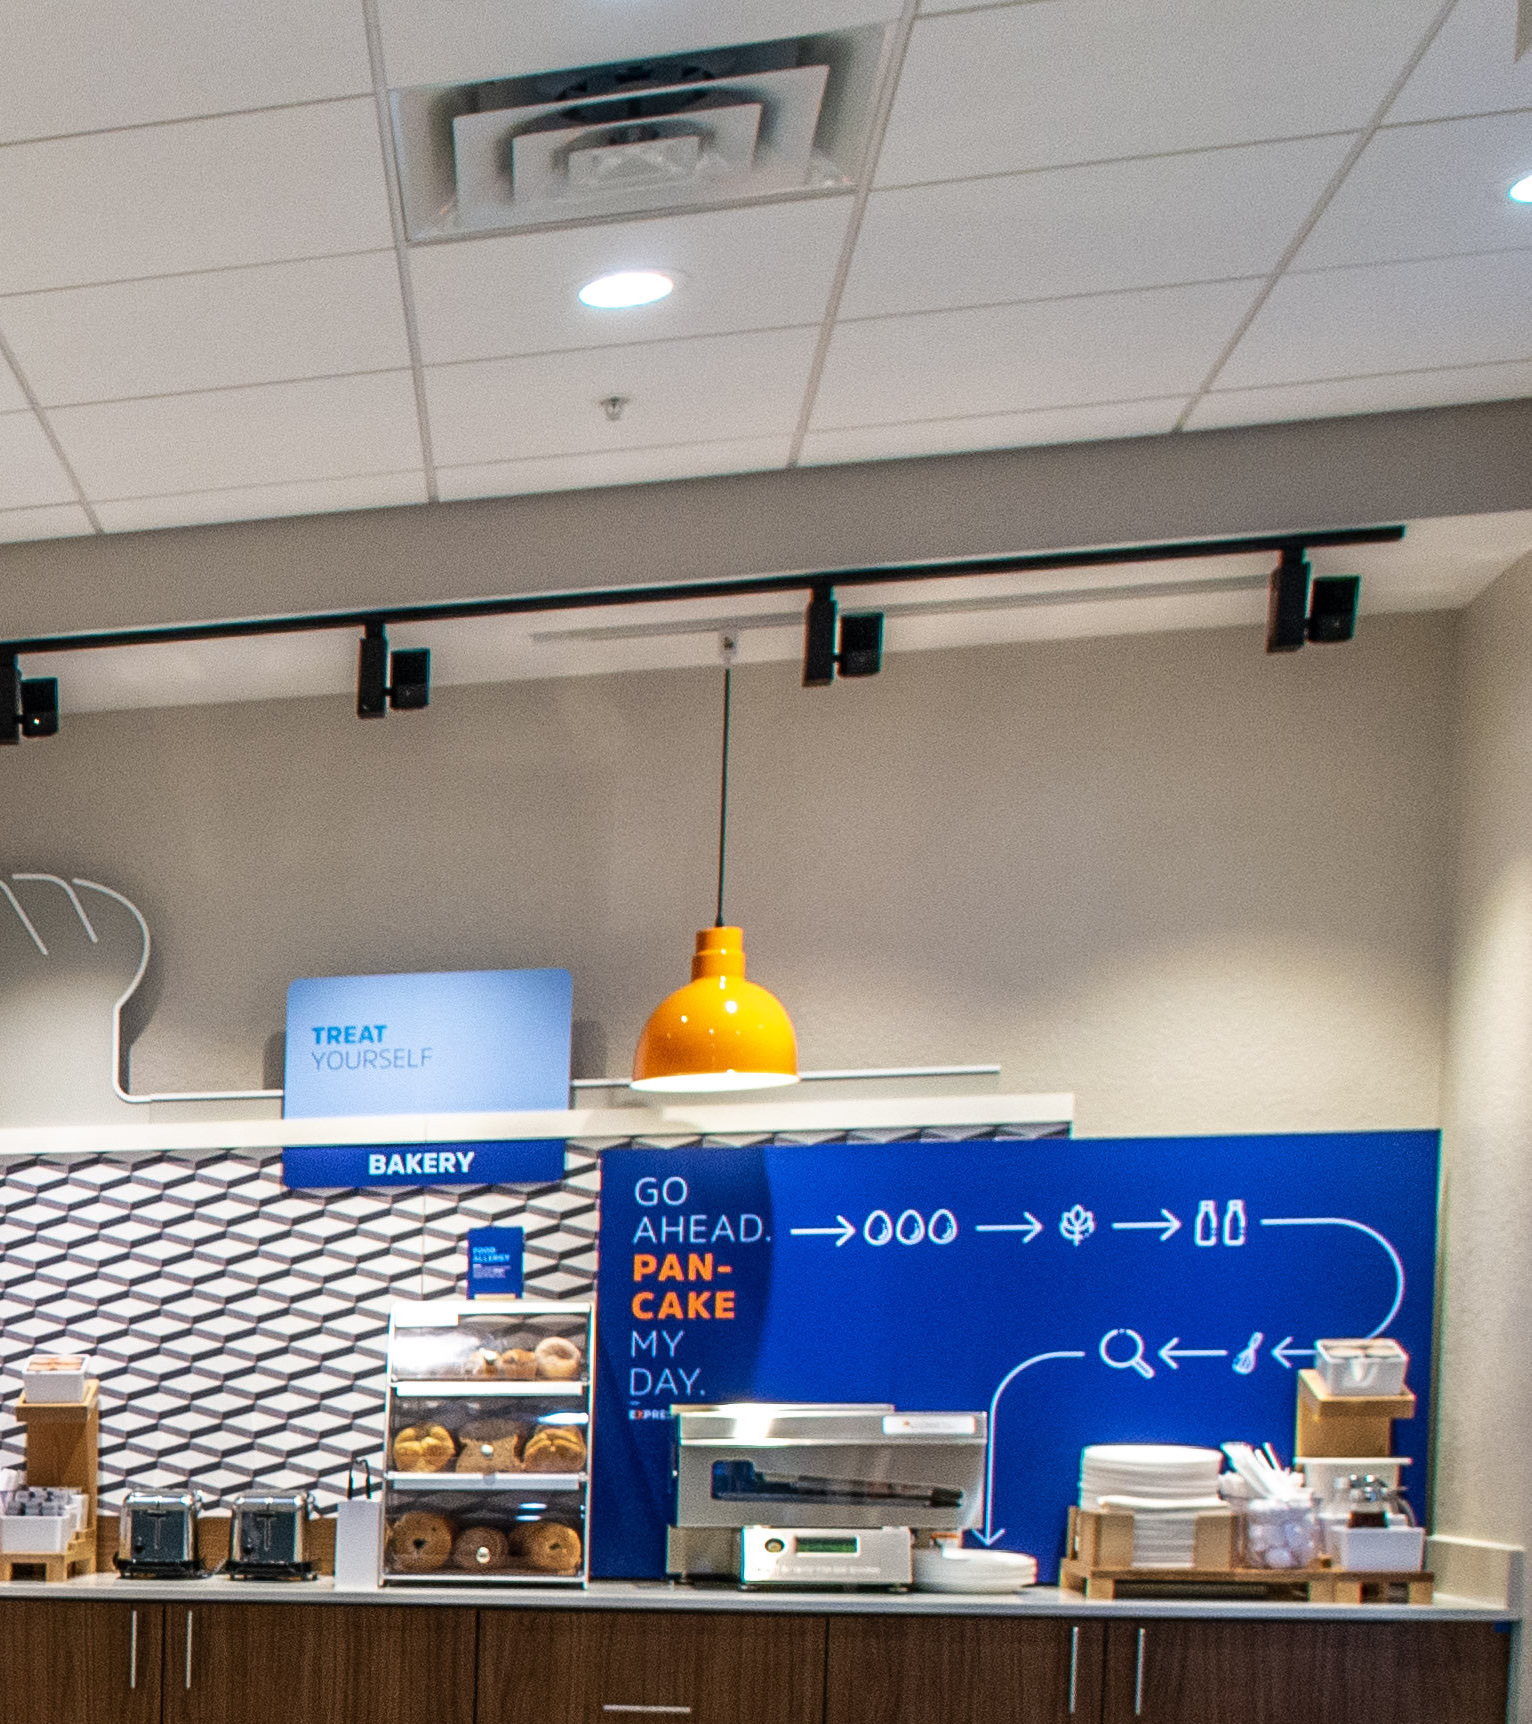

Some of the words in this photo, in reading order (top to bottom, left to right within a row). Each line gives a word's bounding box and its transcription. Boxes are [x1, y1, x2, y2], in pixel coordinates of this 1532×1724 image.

[312, 1025, 387, 1045] TREAT
[311, 1047, 434, 1071] YOURSELF
[368, 1152, 475, 1176] BAKERY
[635, 1177, 688, 1206] GO
[633, 1213, 771, 1244] AHEAD.
[633, 1253, 732, 1282] PAN-
[631, 1291, 736, 1320] CAKE
[631, 1331, 684, 1359] MY
[629, 1368, 706, 1396] DAY.
[629, 1409, 671, 1420] EXPRE
